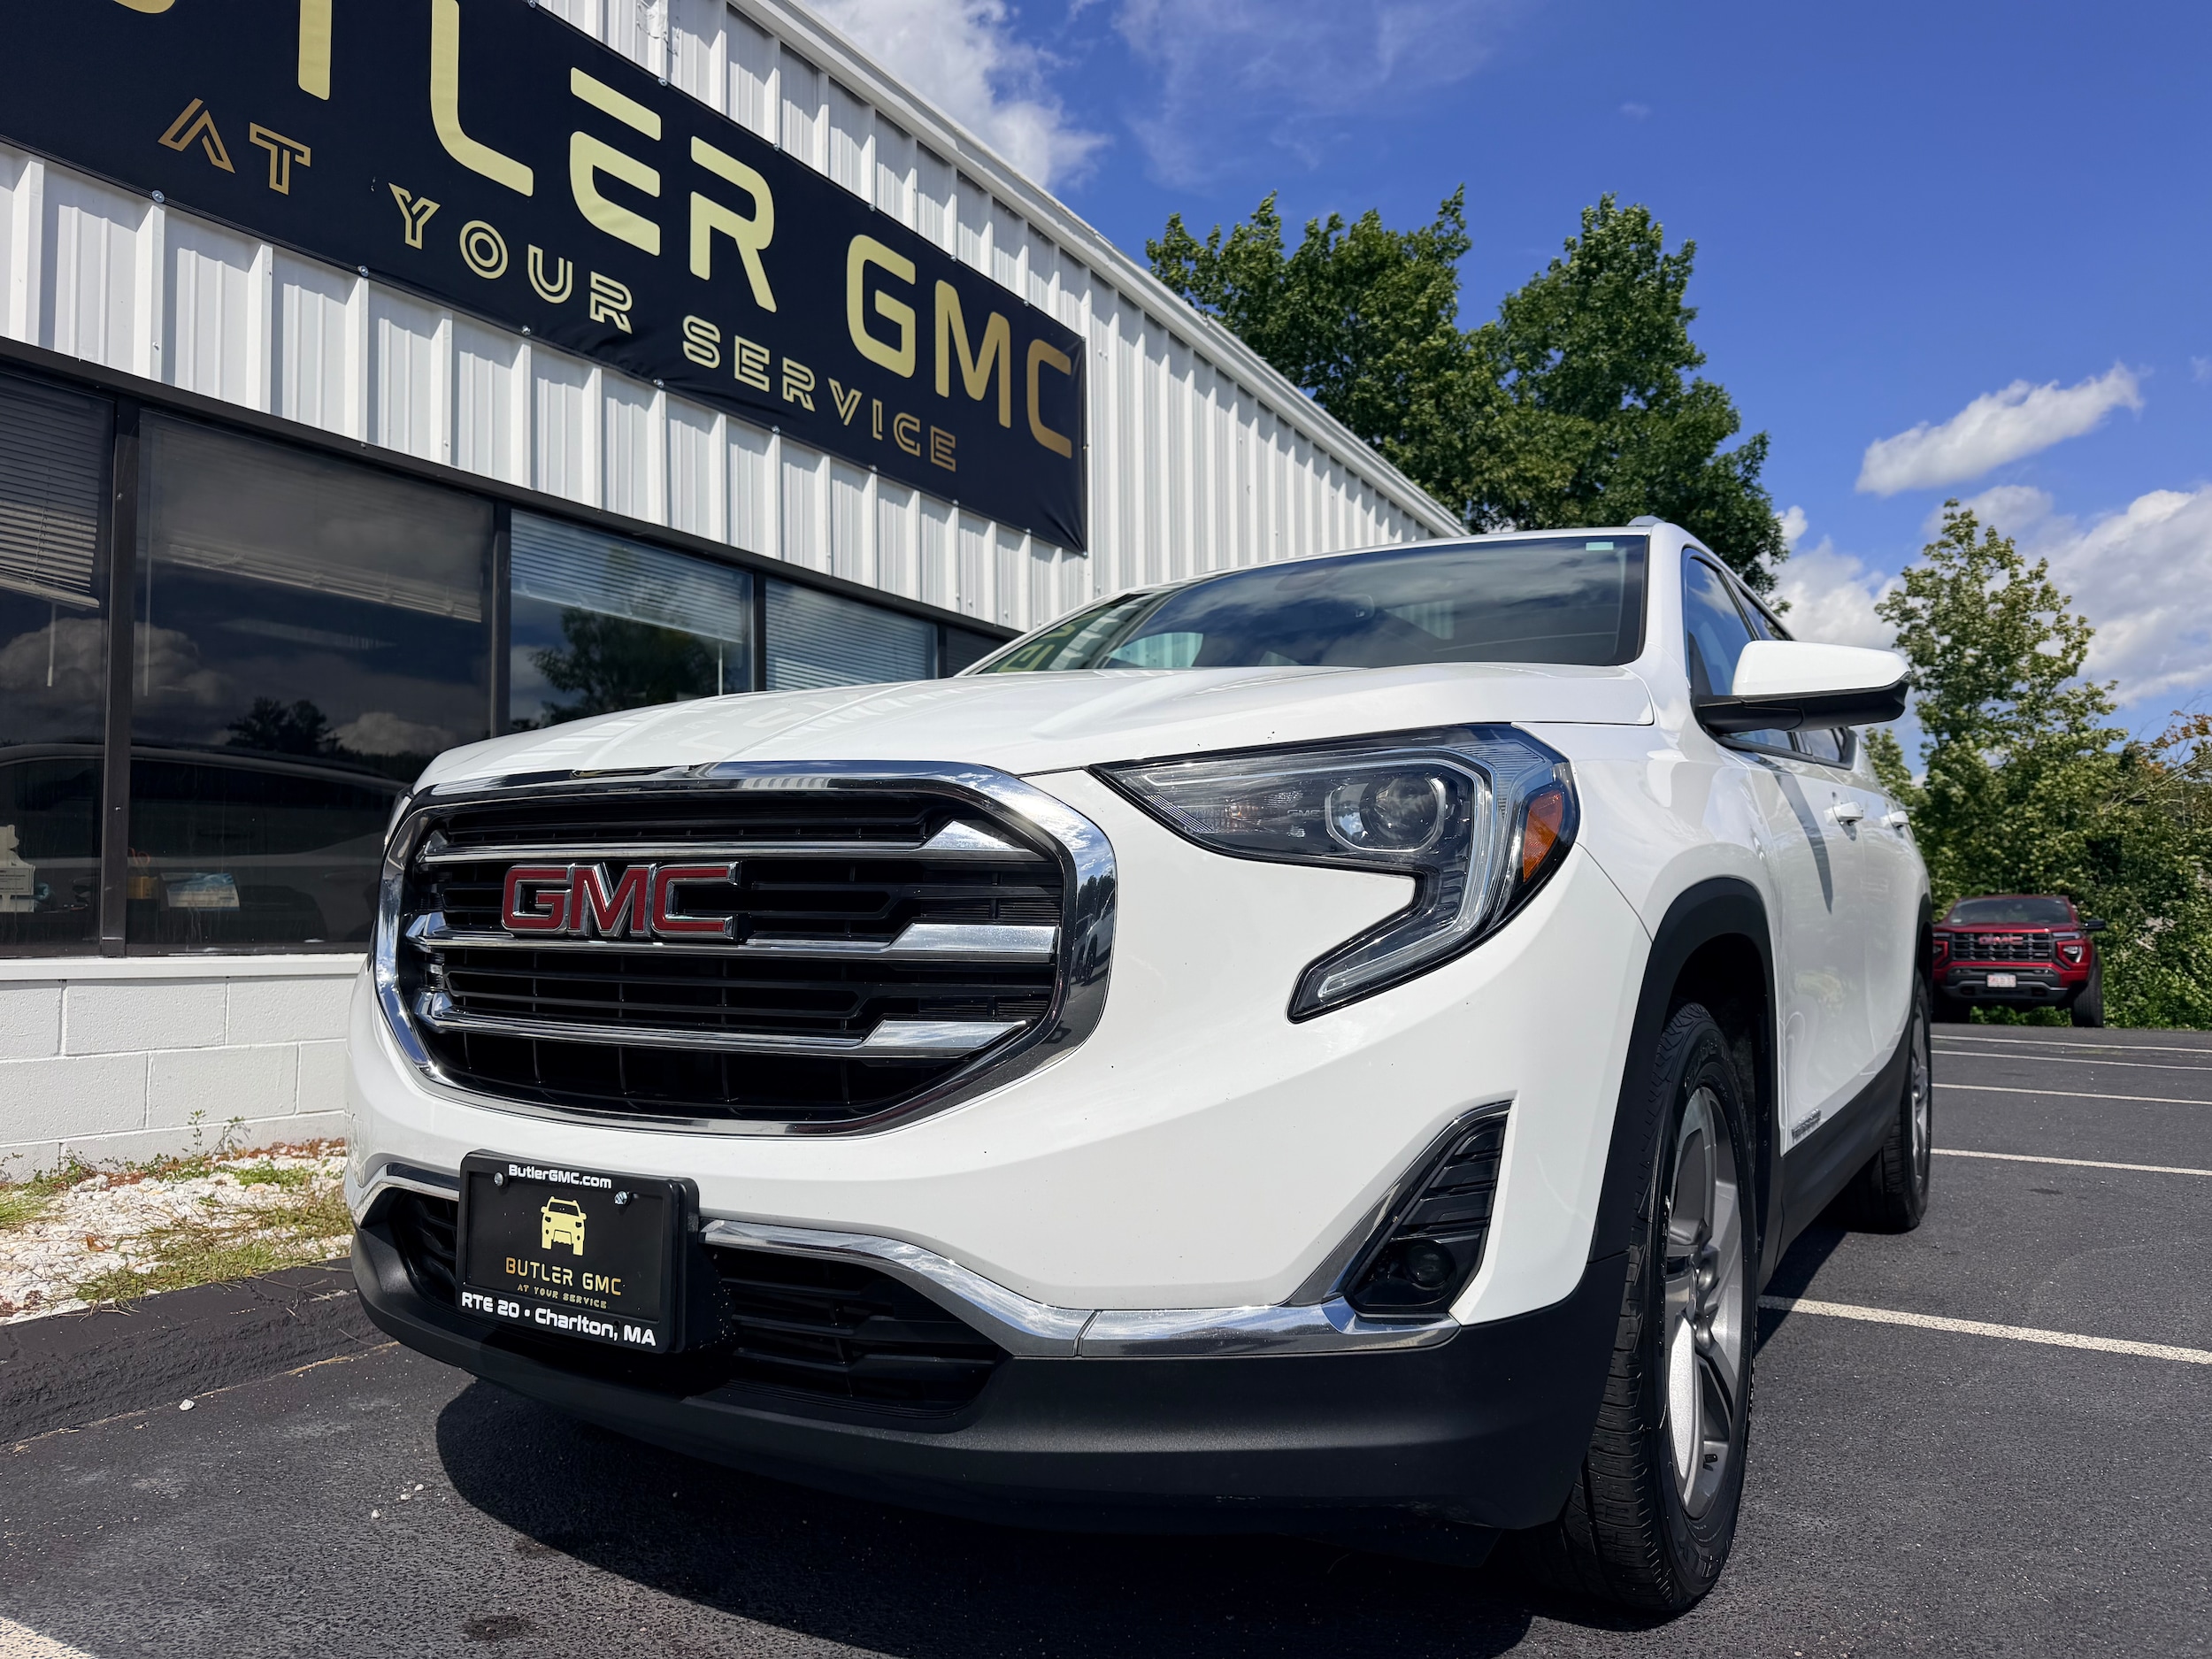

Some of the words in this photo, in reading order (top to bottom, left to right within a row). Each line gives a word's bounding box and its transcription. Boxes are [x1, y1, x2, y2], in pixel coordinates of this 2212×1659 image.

[157, 97, 311, 196] AT
[388, 182, 634, 334] YOUR
[682, 314, 956, 472] SERVICE
[846, 234, 1072, 459] GMC
[502, 862, 741, 939] GMC
[509, 1164, 612, 1189] ButlerGMC.com
[505, 1256, 573, 1286] BUTLER
[582, 1272, 621, 1295] GMC
[534, 1286, 558, 1299] YOUR
[563, 1292, 607, 1310] SERVICE
[461, 1292, 494, 1312] RTE
[497, 1300, 519, 1318] 20
[534, 1308, 618, 1340] Charlton,
[624, 1325, 657, 1346] MA
